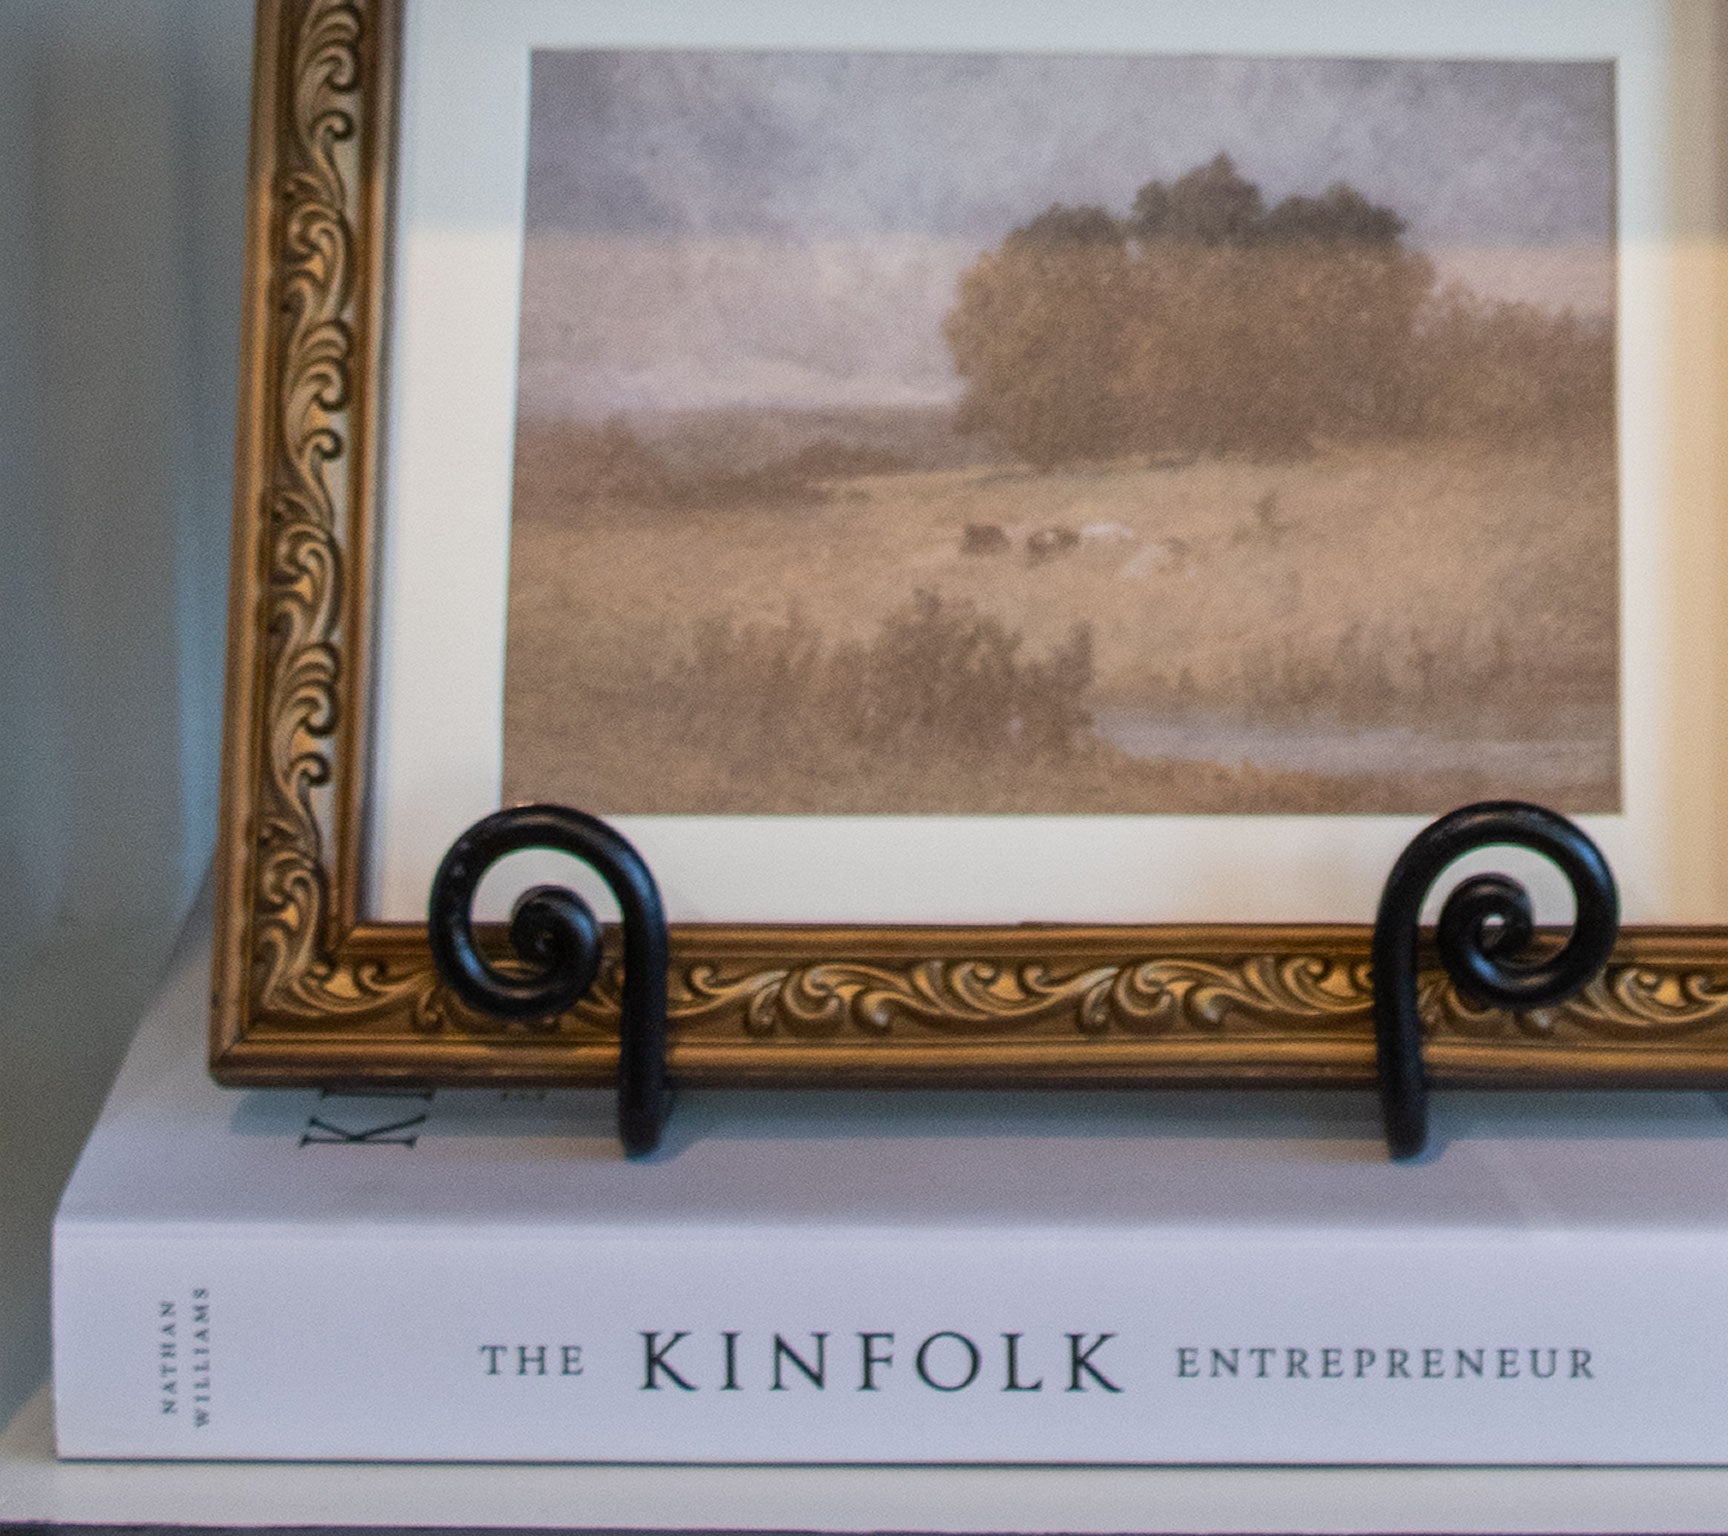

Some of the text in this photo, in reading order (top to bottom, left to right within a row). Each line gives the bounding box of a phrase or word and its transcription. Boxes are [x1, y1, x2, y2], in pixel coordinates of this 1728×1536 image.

[159, 1301, 177, 1415] NATHAN
[192, 1287, 211, 1428] WILLIAMS
[479, 1331, 1594, 1394] THE KINFOLK ENTREPRENEUR
